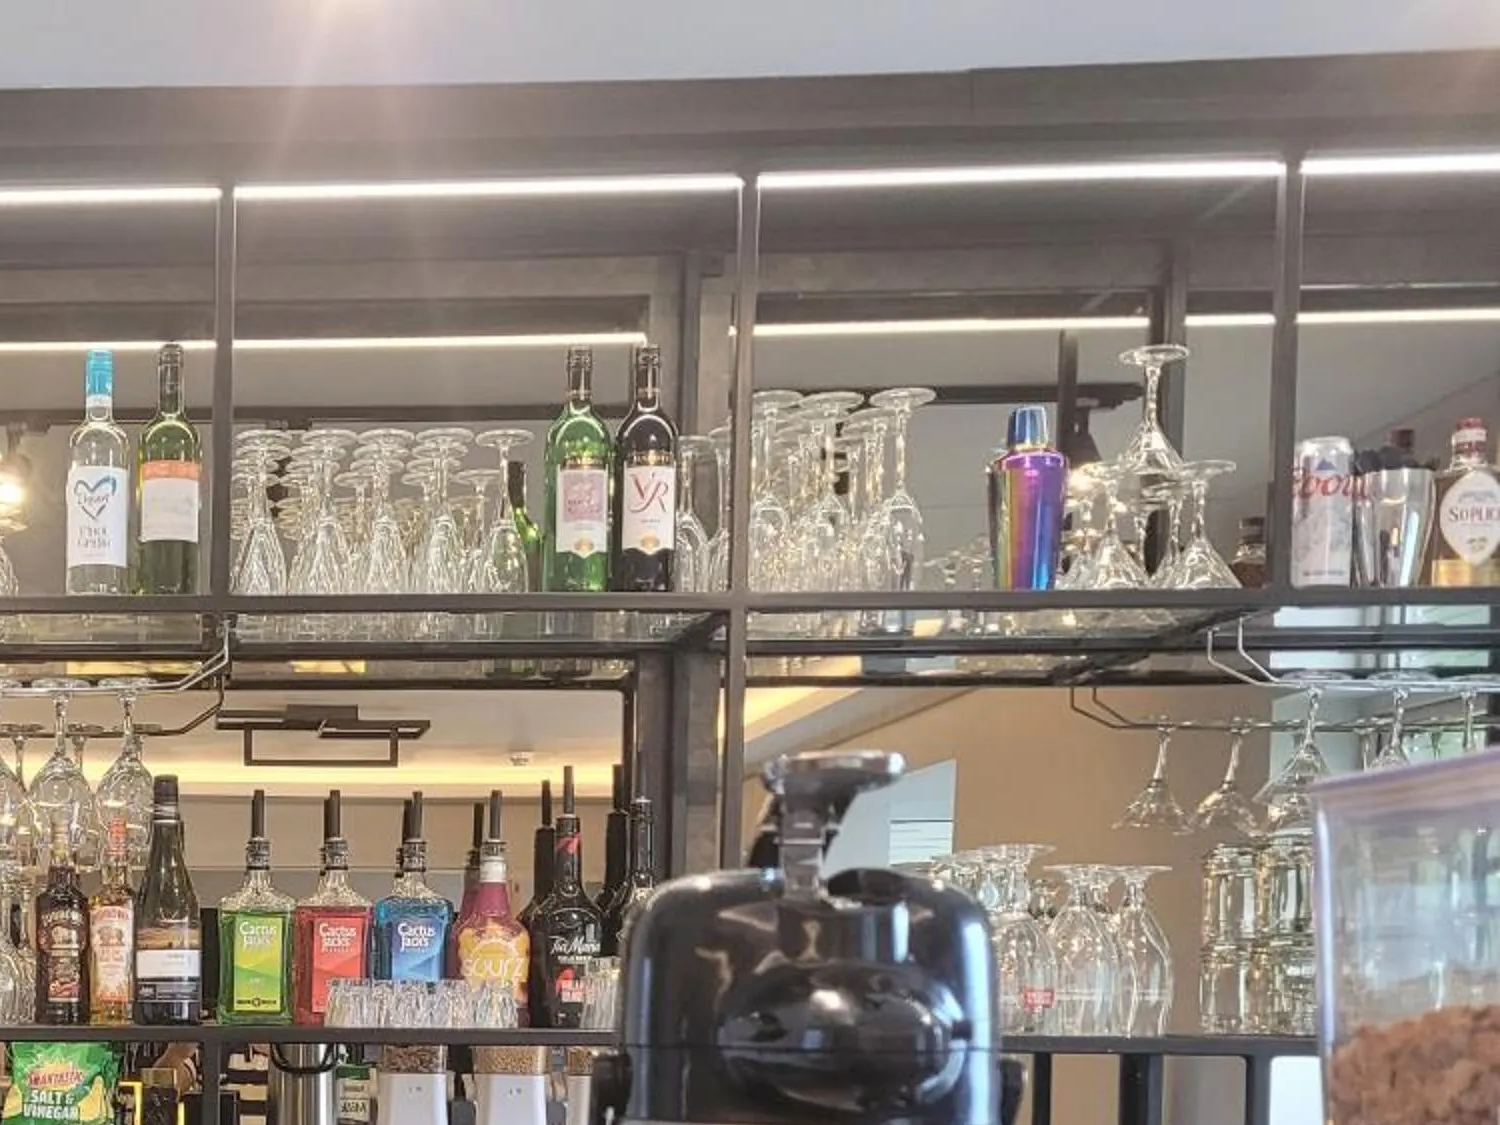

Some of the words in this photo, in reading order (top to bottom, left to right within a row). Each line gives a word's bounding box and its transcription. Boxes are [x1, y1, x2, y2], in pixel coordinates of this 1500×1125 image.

[397, 922, 436, 938] Cactus
[31, 1089, 62, 1105] SALT
[23, 1102, 79, 1120] VINEGAR
